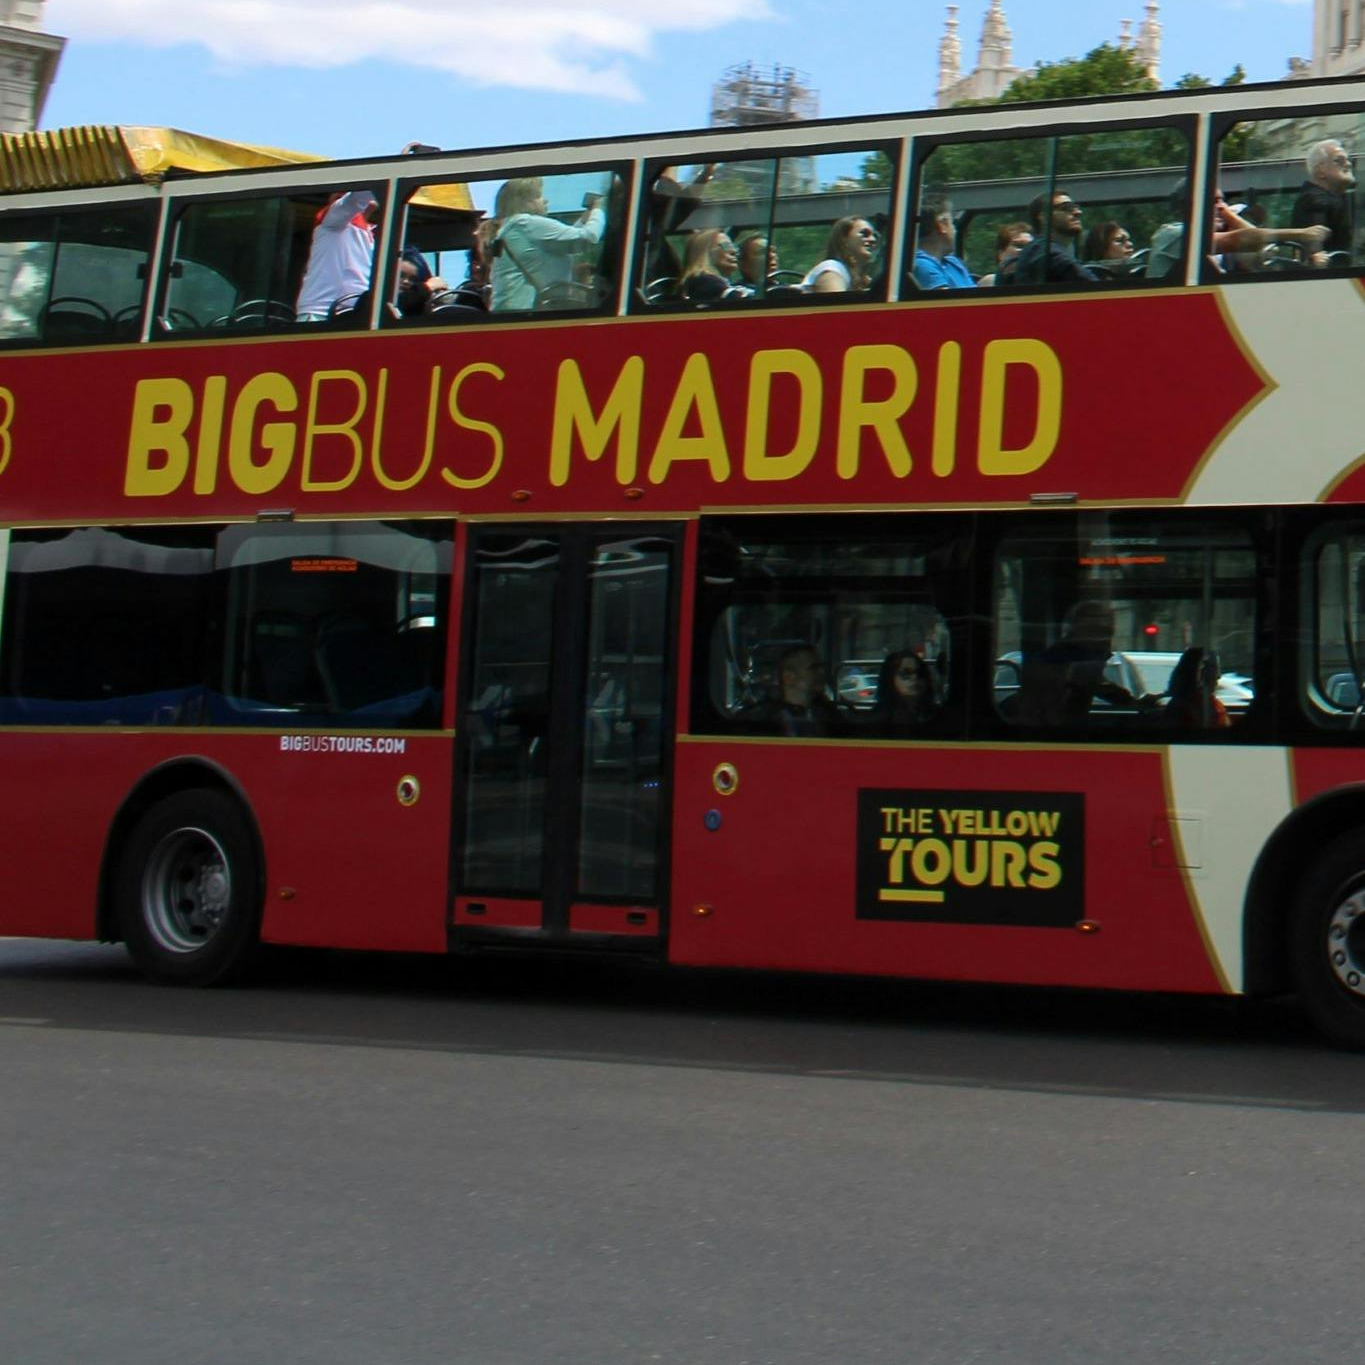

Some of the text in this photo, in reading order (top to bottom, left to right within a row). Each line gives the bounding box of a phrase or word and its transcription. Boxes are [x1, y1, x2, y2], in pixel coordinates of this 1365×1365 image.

[124, 360, 505, 497] BIGBUS
[548, 337, 1064, 487] MADRID
[280, 736, 405, 753] BIGBUSTOURS.COM
[880, 808, 1060, 836] THE YELLOW
[879, 838, 1062, 888] TOURS
